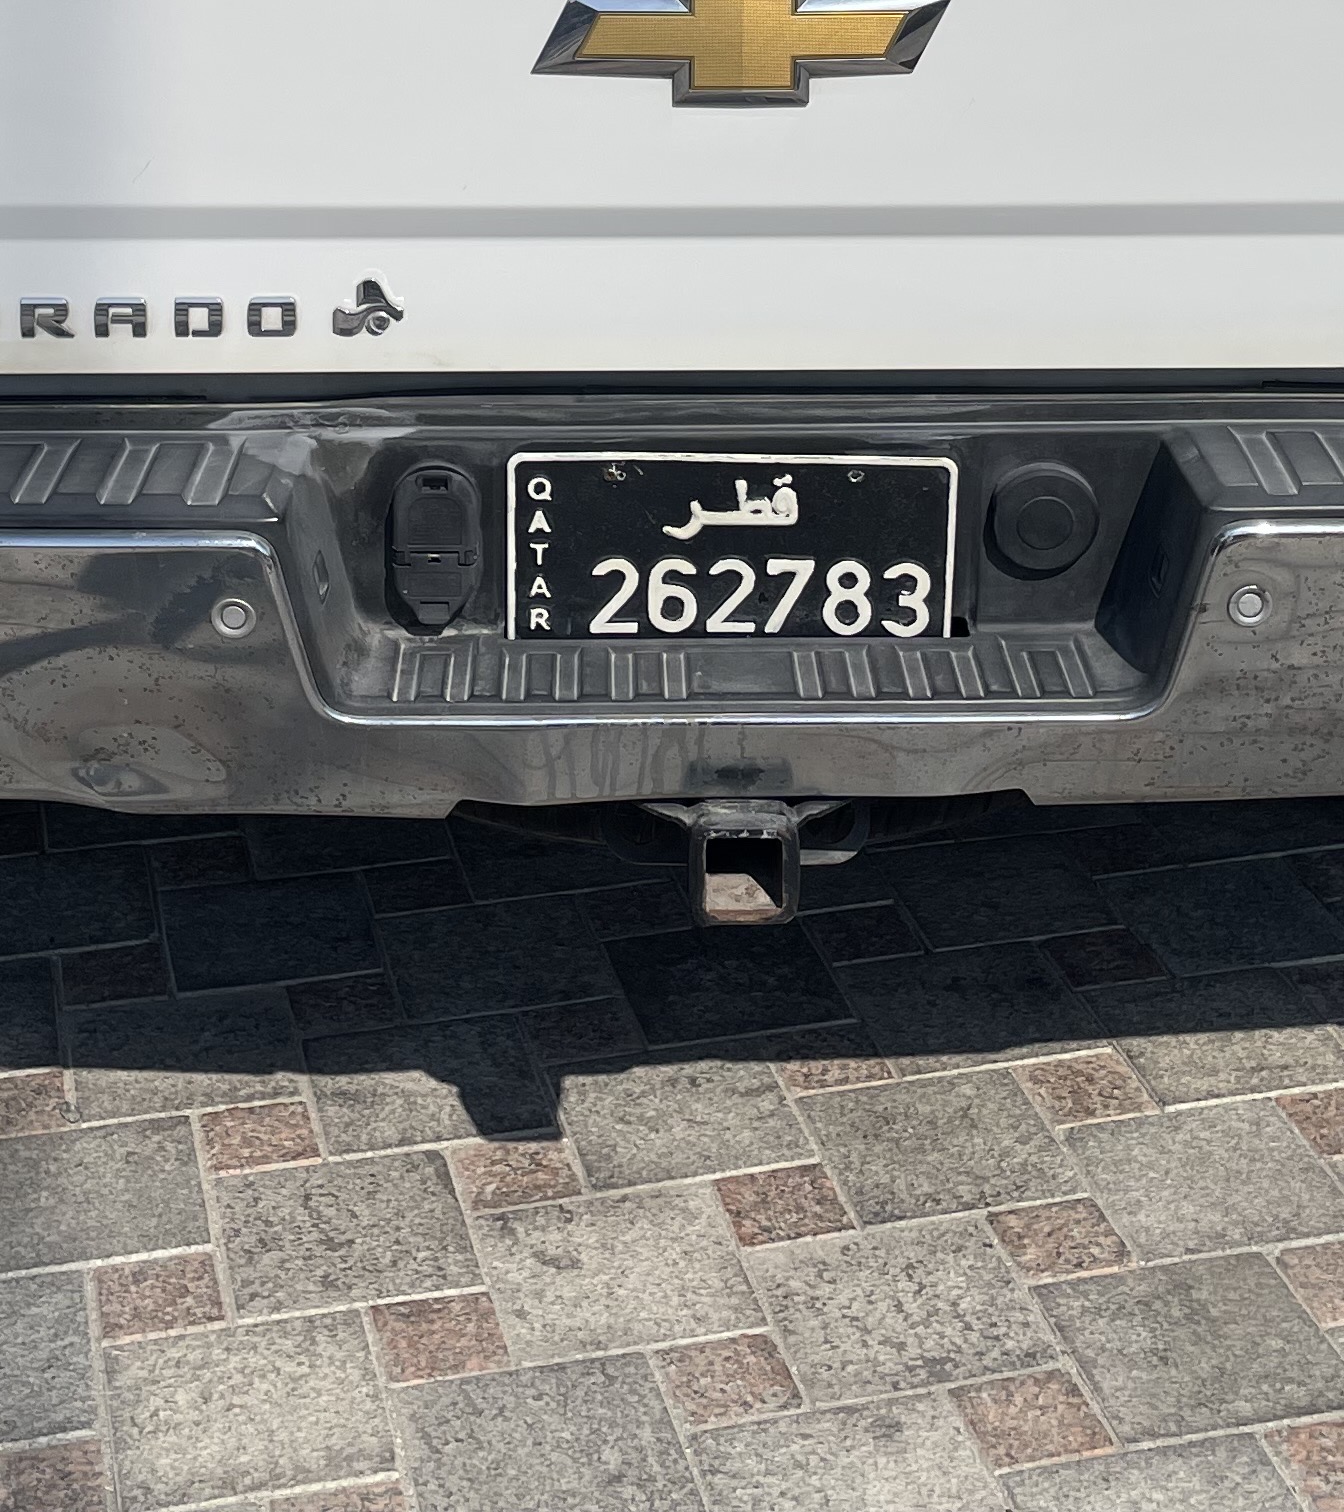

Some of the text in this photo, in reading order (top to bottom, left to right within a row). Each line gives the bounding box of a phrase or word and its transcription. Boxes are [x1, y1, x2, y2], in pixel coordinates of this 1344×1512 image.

[662, 473, 799, 540] قطر
[527, 477, 552, 631] QATAR
[589, 558, 931, 638] 262783
